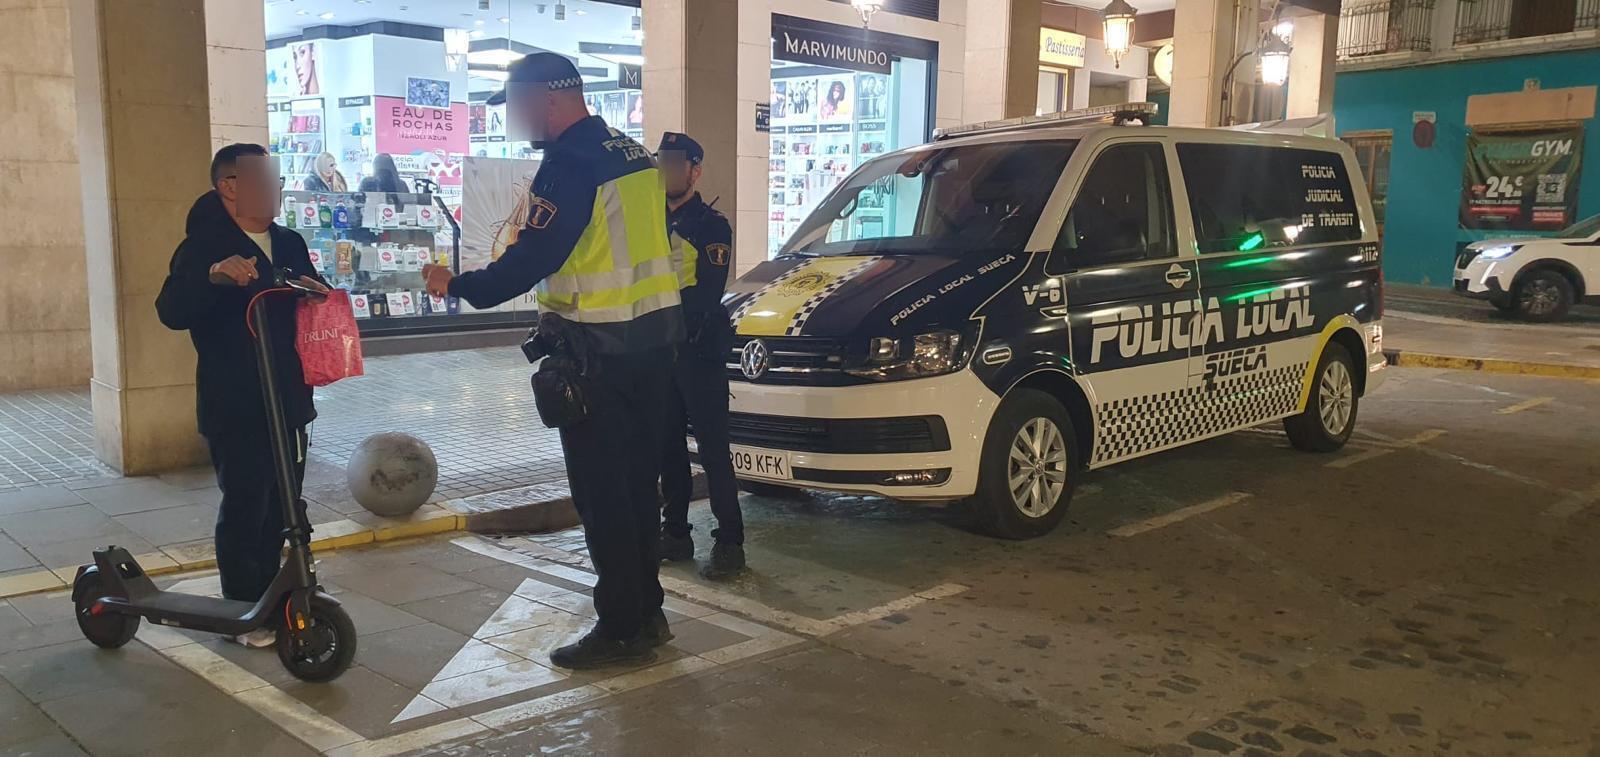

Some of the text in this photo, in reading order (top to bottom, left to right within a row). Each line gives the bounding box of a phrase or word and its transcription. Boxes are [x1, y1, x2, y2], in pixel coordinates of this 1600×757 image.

[784, 31, 887, 66] MARVIMUNDO
[1046, 37, 1085, 58] Pastisseria
[392, 107, 453, 121] EAU DE
[393, 119, 453, 131] ROCHAS
[624, 146, 652, 161] LOCA
[1301, 165, 1335, 179] POLICIA
[1305, 189, 1343, 202] JUDICIAL
[1302, 213, 1314, 227] DE
[890, 253, 1016, 326] POLICIA LOCAL SUECA
[1090, 285, 1315, 364] POLICIA LOCAL
[304, 327, 338, 343] DRUNI
[1203, 345, 1268, 381] SUECA
[756, 454, 783, 475] KFK
